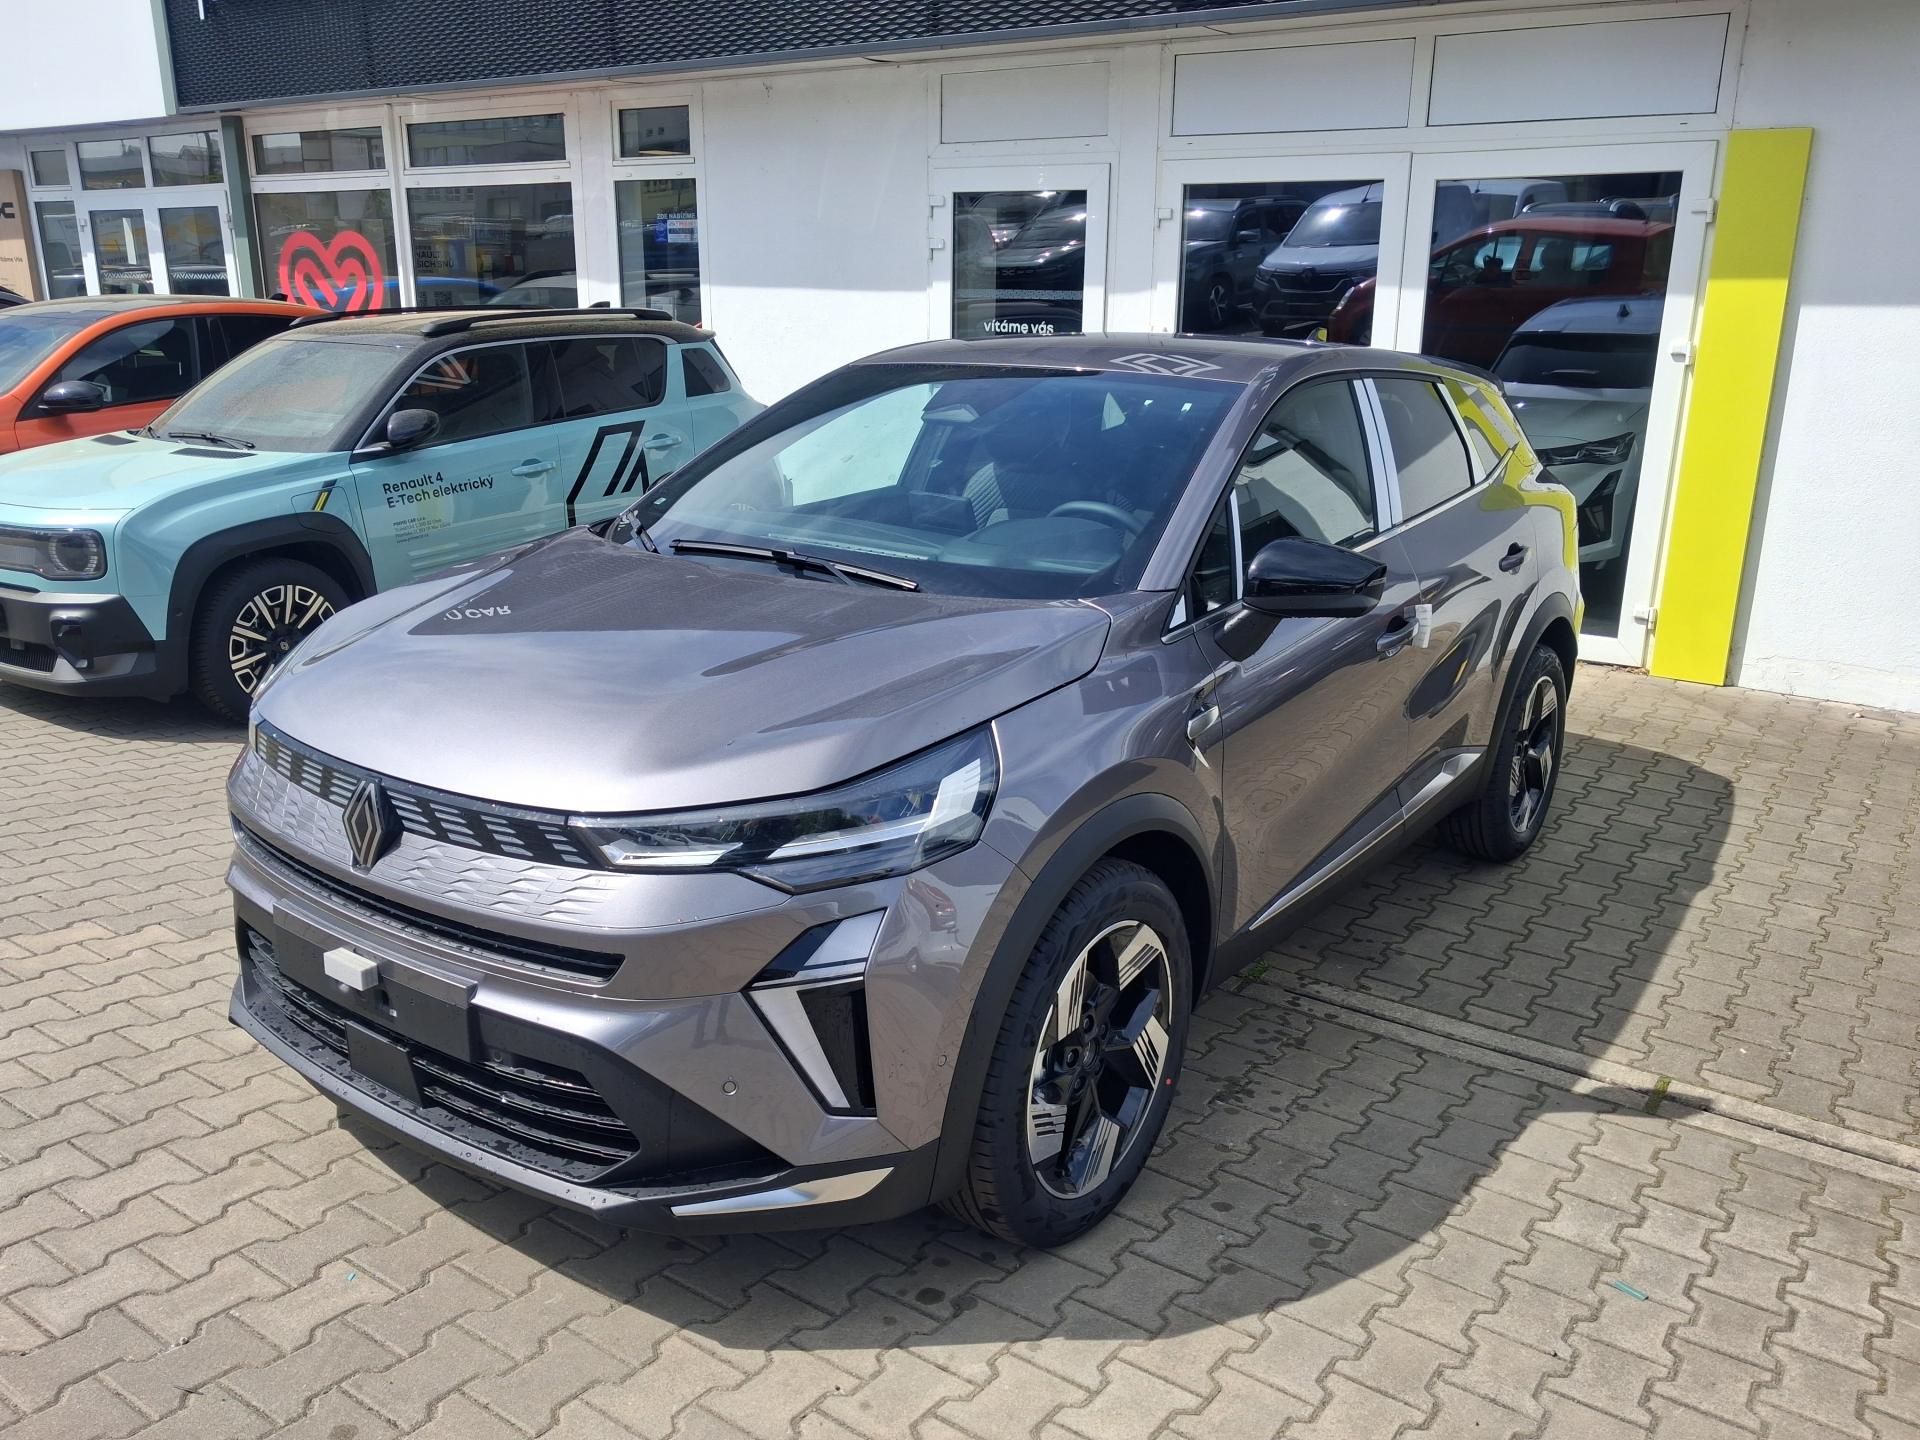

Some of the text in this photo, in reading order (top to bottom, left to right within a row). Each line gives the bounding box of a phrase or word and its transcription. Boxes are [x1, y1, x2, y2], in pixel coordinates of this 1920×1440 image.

[983, 319, 1054, 335] vítáme vás
[382, 471, 444, 495] Renault 4
[386, 474, 494, 509] E-Tech elektrický
